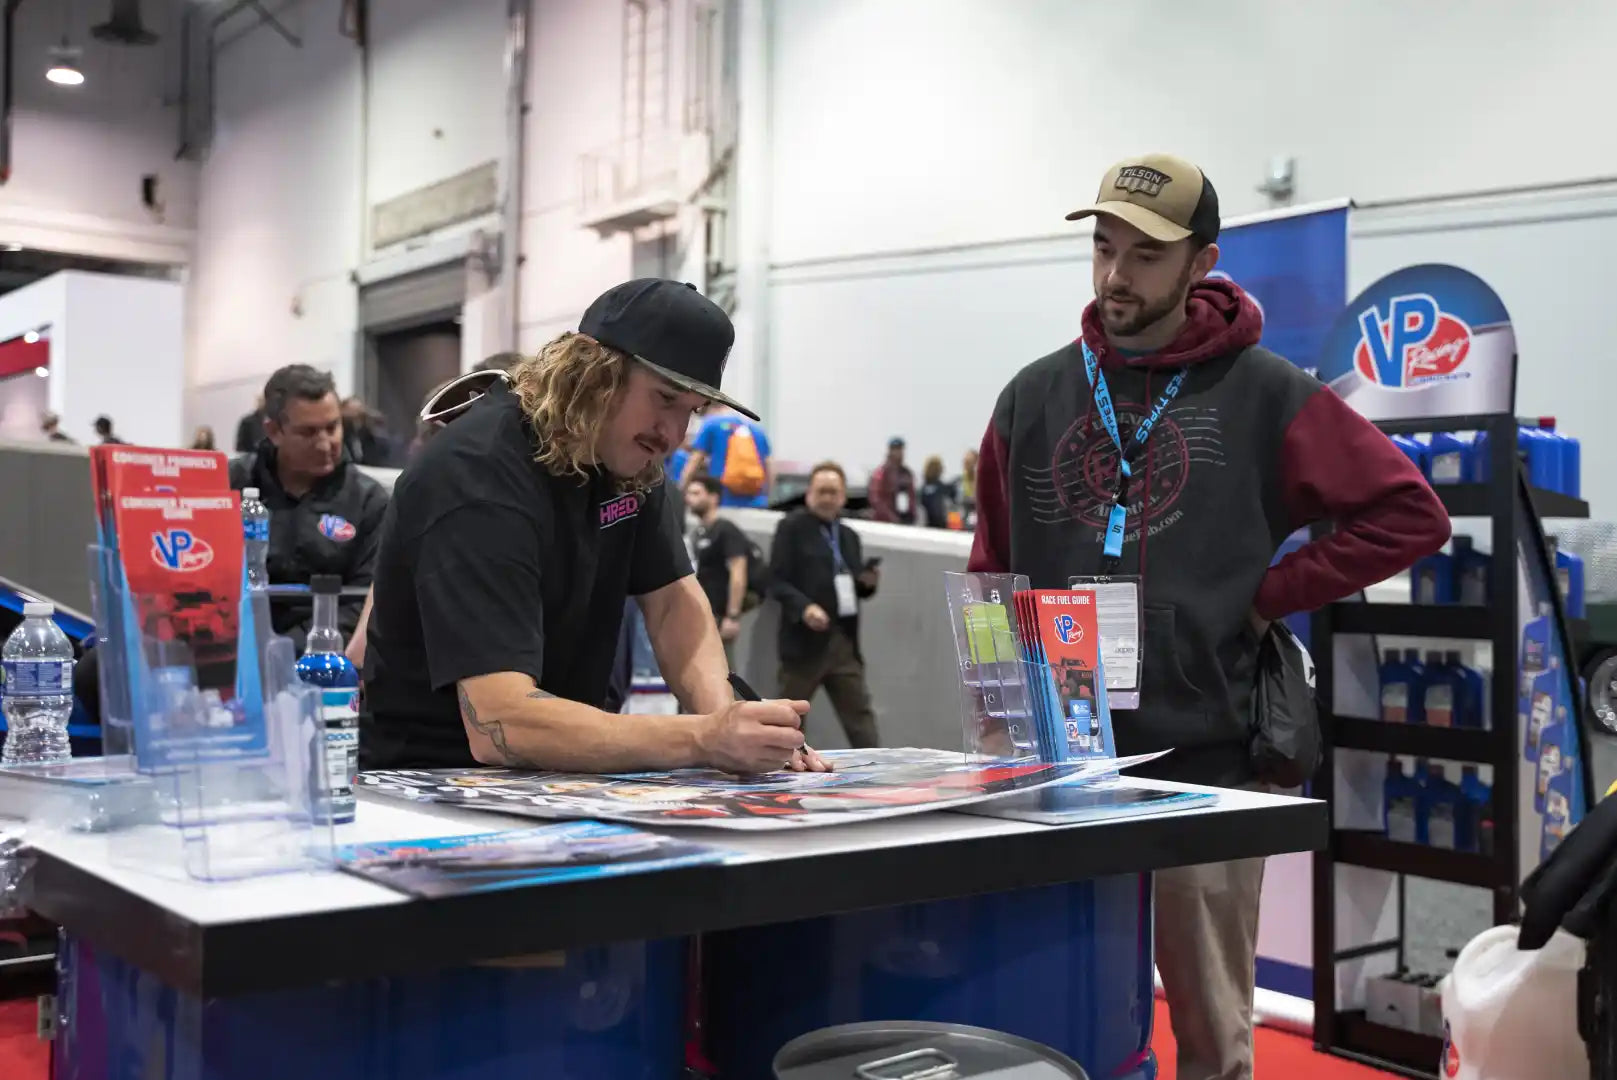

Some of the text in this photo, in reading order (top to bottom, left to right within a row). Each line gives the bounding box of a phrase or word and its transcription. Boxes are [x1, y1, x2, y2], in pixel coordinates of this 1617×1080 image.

[1122, 167, 1162, 184] FILSON
[1358, 293, 1440, 389] VP
[1135, 396, 1169, 444] TYPES
[152, 529, 193, 569] VP
[1041, 594, 1090, 605] RACE FUEL GUIDE
[1054, 614, 1074, 644] VP
